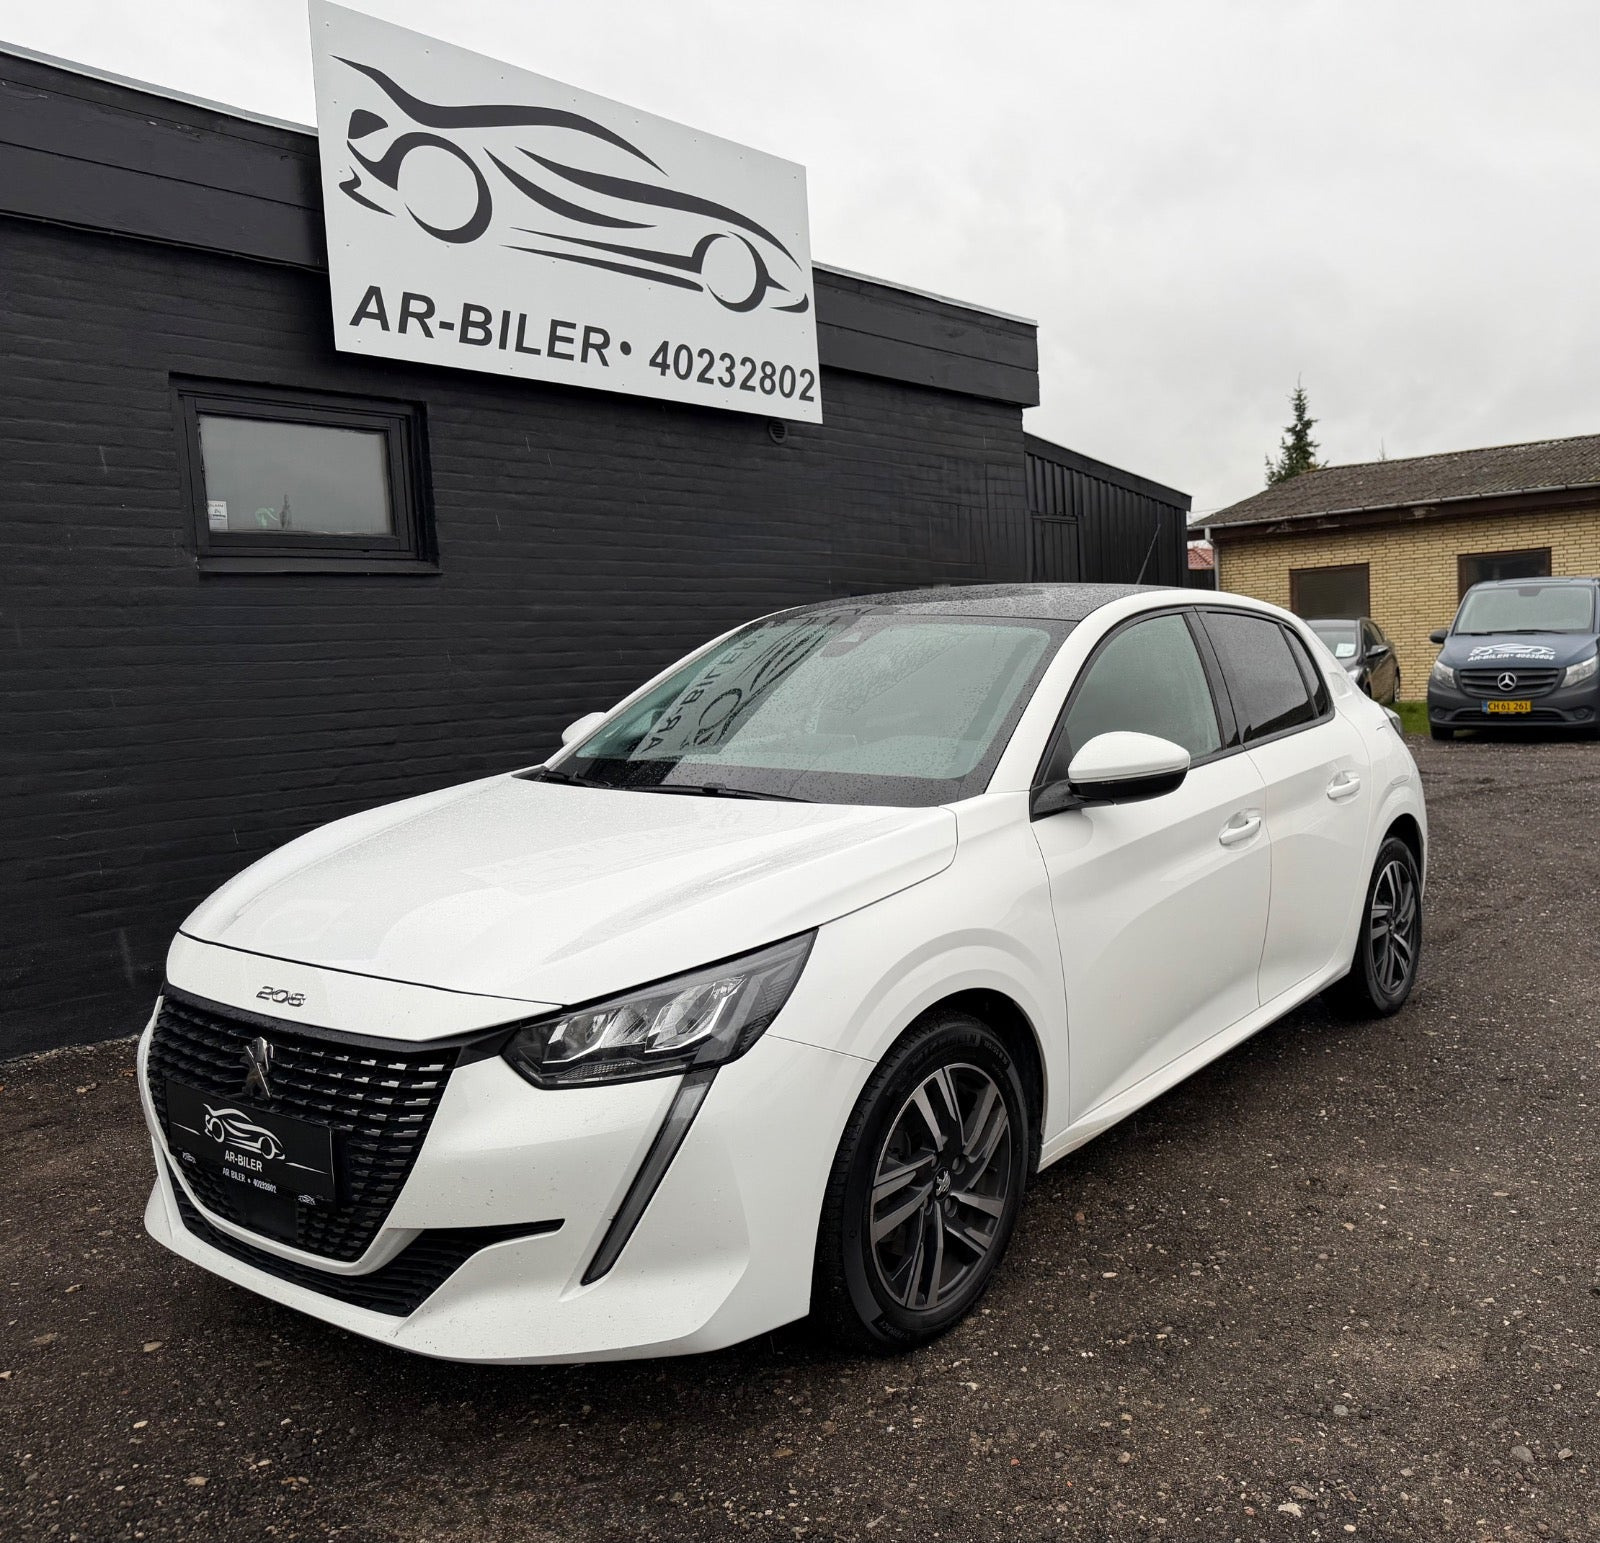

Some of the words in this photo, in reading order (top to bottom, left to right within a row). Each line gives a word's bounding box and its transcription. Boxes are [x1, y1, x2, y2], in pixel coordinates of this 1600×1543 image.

[349, 285, 611, 368] AR-BILER
[649, 340, 815, 403] 40232802
[1487, 702, 1499, 711] CH
[1501, 702, 1510, 711] 61
[1513, 702, 1529, 711] 261
[224, 1150, 263, 1173] AR-BILER
